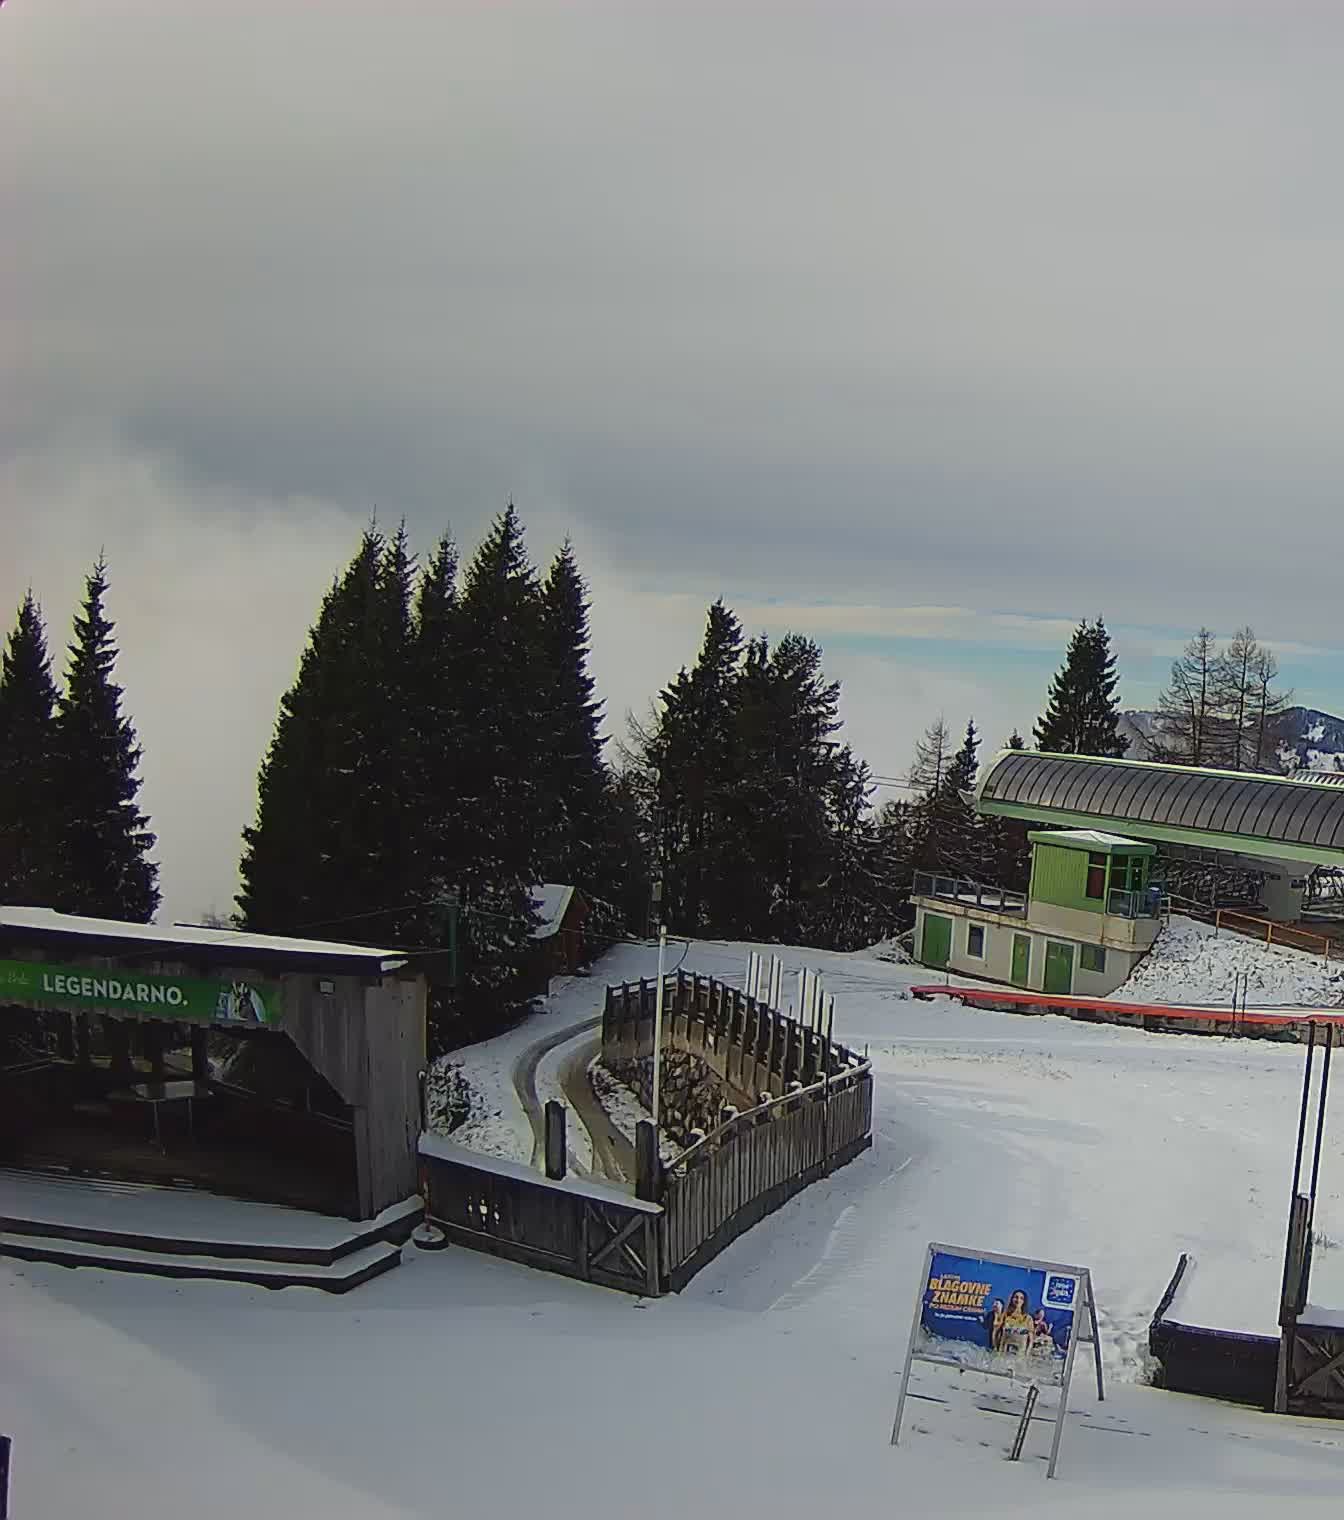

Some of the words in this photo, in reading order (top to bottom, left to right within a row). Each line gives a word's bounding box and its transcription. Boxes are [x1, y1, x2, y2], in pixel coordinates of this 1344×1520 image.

[43, 973, 188, 1006] LEGENDARNO.
[929, 1278, 992, 1295] BLAGOVNE
[932, 1291, 985, 1306] ZNAMKE
